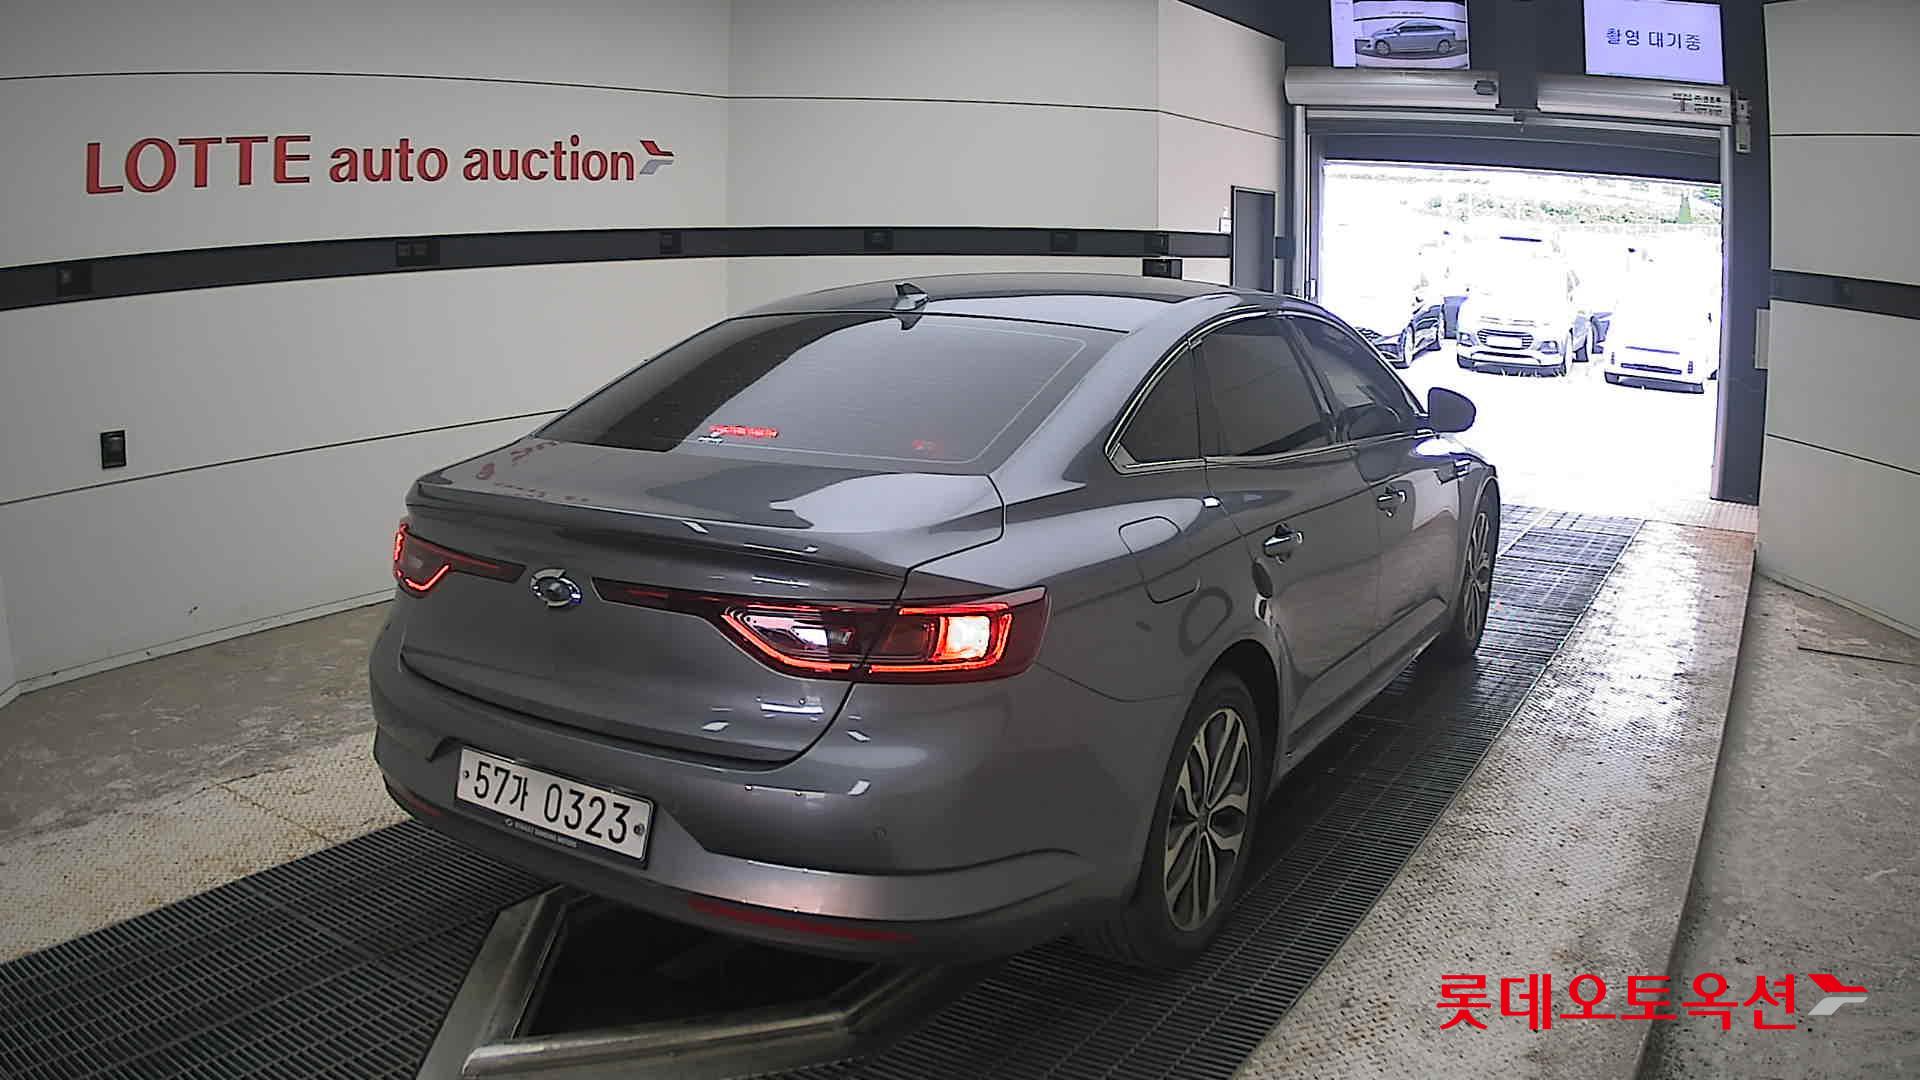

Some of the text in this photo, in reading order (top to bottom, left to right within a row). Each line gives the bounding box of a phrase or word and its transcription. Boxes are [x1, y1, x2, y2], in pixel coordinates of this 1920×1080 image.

[1648, 32, 1701, 51] 대기중
[86, 134, 635, 194] LOTTE auto auction
[473, 760, 529, 812] 57가
[544, 783, 631, 844] 0323
